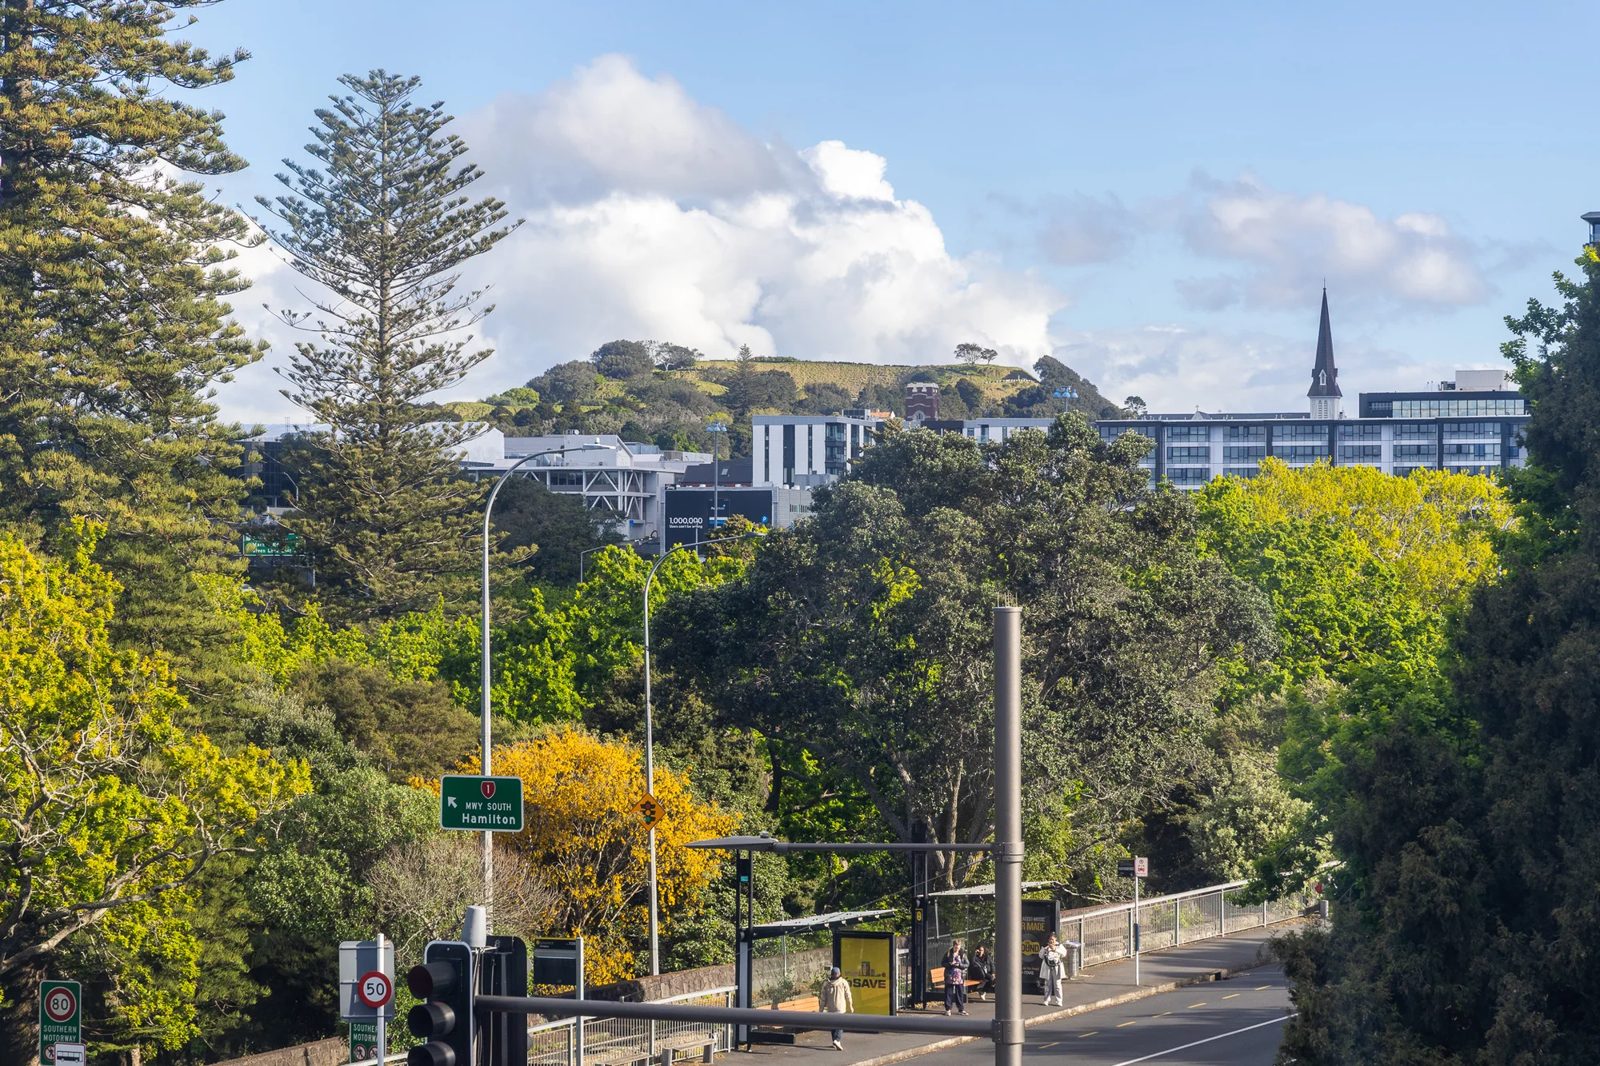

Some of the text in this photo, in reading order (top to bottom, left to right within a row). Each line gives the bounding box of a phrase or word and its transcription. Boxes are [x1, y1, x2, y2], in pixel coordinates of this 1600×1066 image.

[465, 802, 512, 811] MWY SOUTH
[462, 813, 516, 825] Hamilton
[1021, 944, 1039, 953] OUND
[366, 983, 385, 996] 50
[52, 998, 69, 1011] 80
[43, 1025, 77, 1033] SOUTHERN
[353, 1023, 378, 1032] SOUTHER
[43, 1034, 77, 1042] MOTORWAY
[353, 1033, 378, 1042] MOTORW
